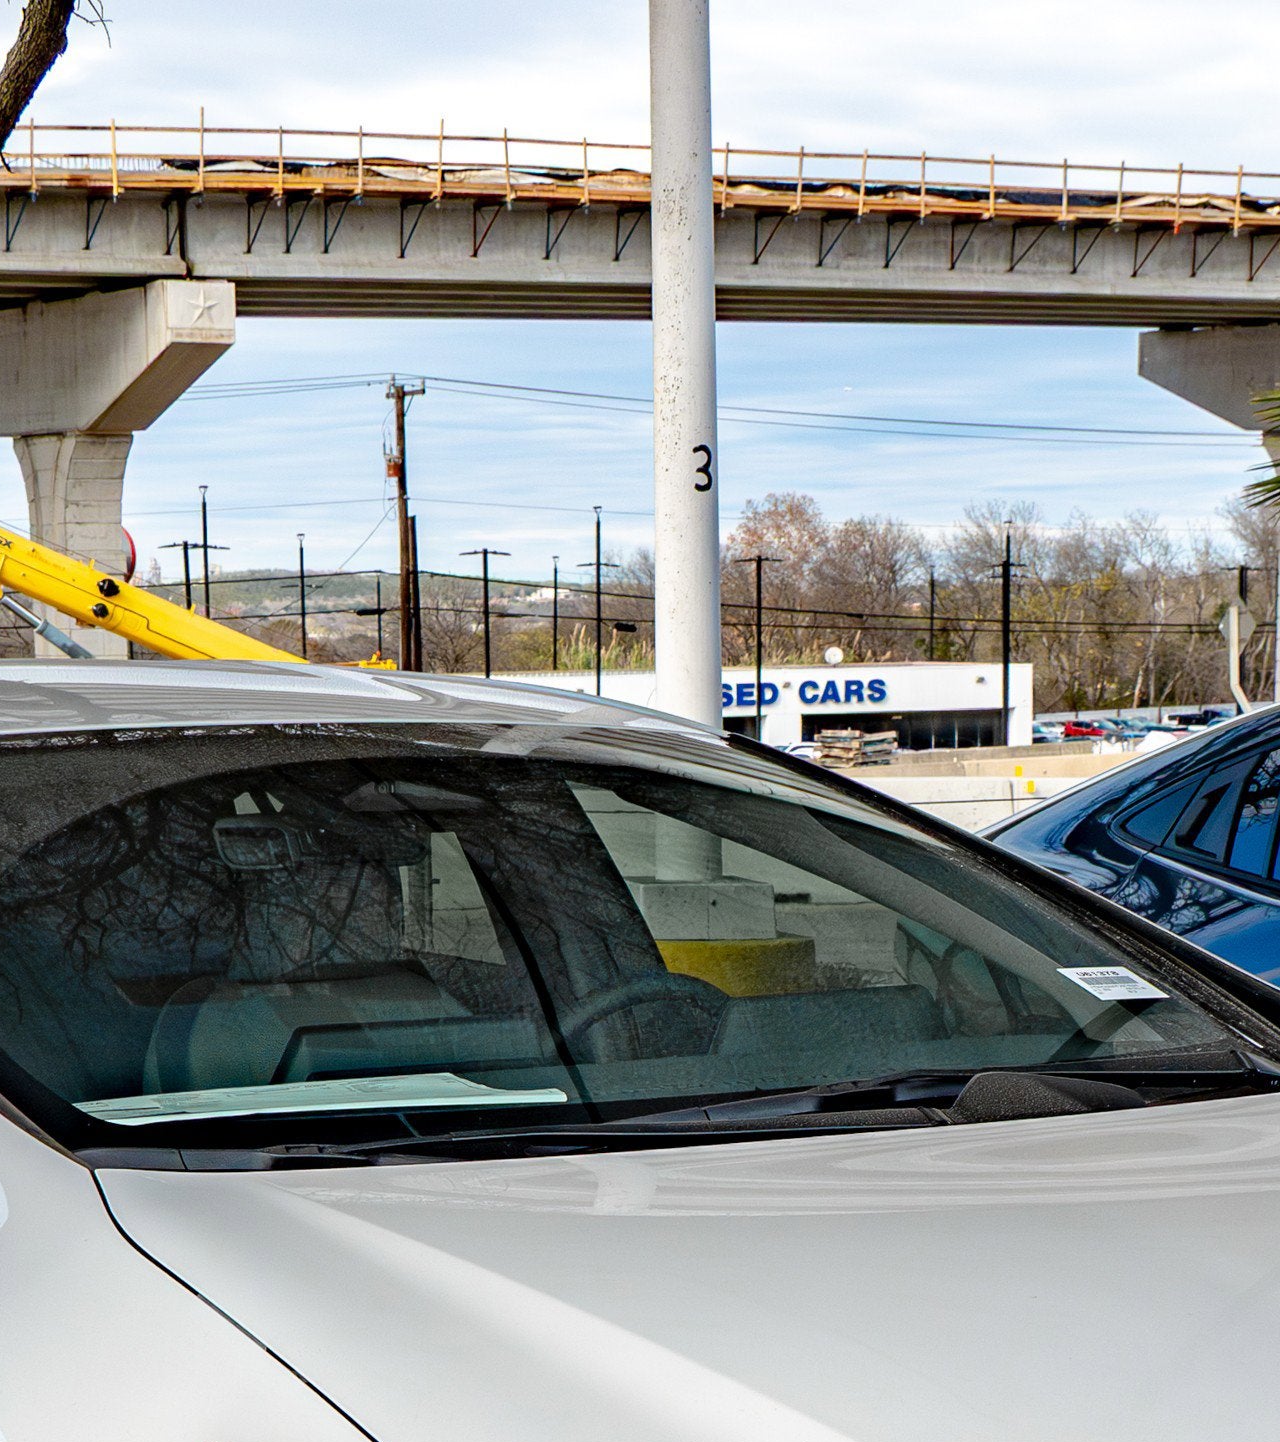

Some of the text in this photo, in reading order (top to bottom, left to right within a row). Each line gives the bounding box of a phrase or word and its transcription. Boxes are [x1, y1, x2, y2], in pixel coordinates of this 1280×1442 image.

[692, 444, 713, 492] 3
[721, 679, 887, 707] SED CARS
